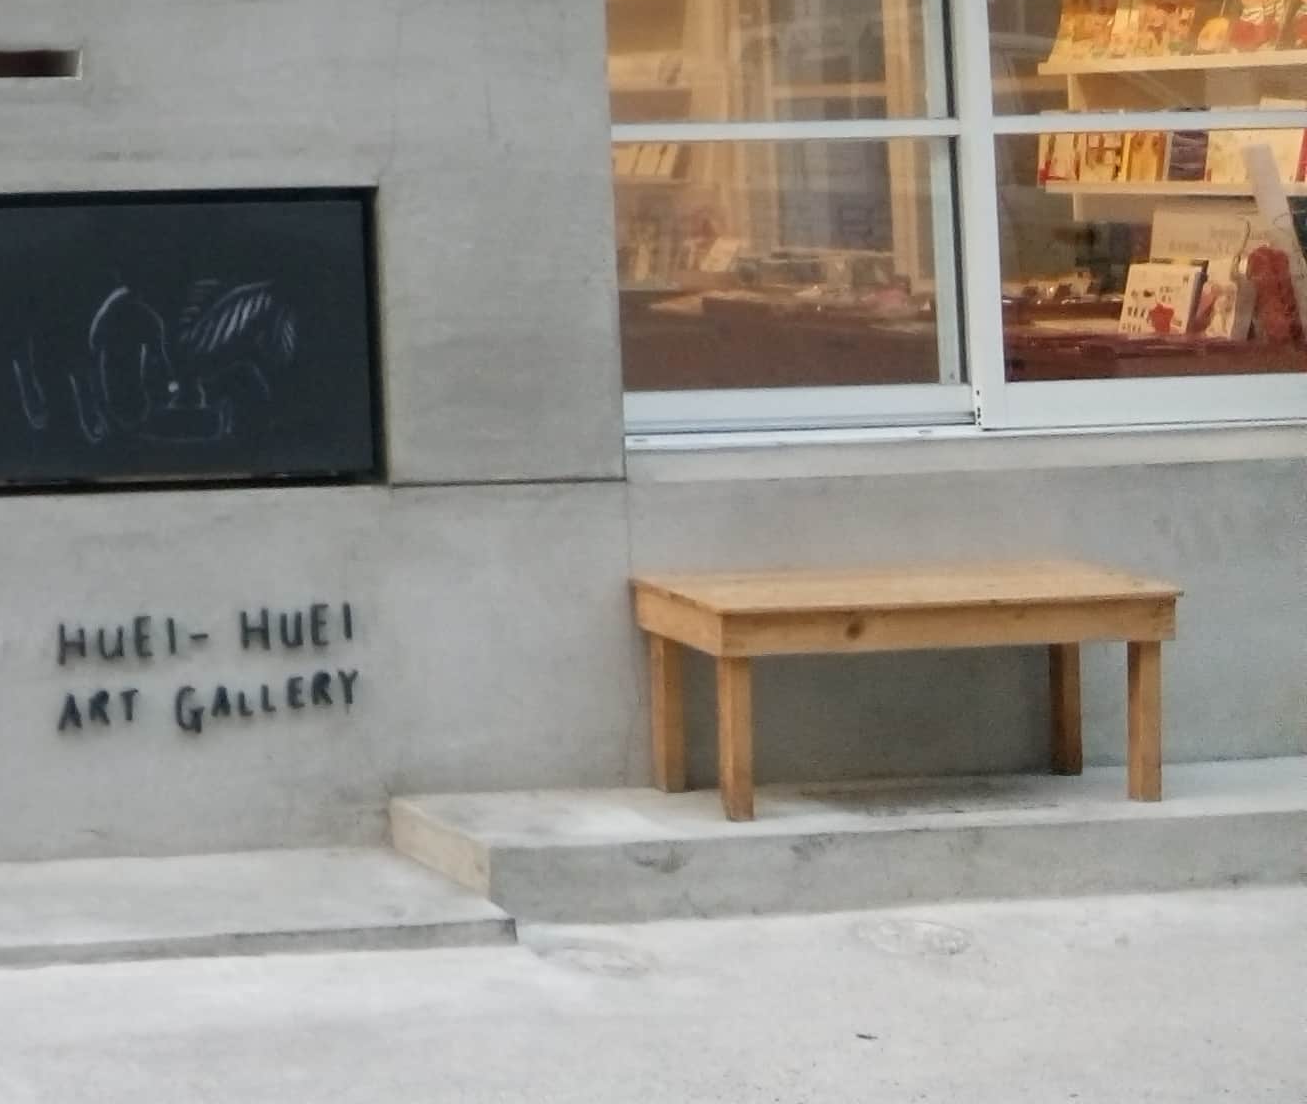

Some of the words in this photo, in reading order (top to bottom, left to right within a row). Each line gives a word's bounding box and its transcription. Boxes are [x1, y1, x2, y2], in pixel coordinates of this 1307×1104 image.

[240, 601, 354, 651] HUEI
[57, 688, 139, 731] ART
[174, 669, 358, 734] GALLERY
